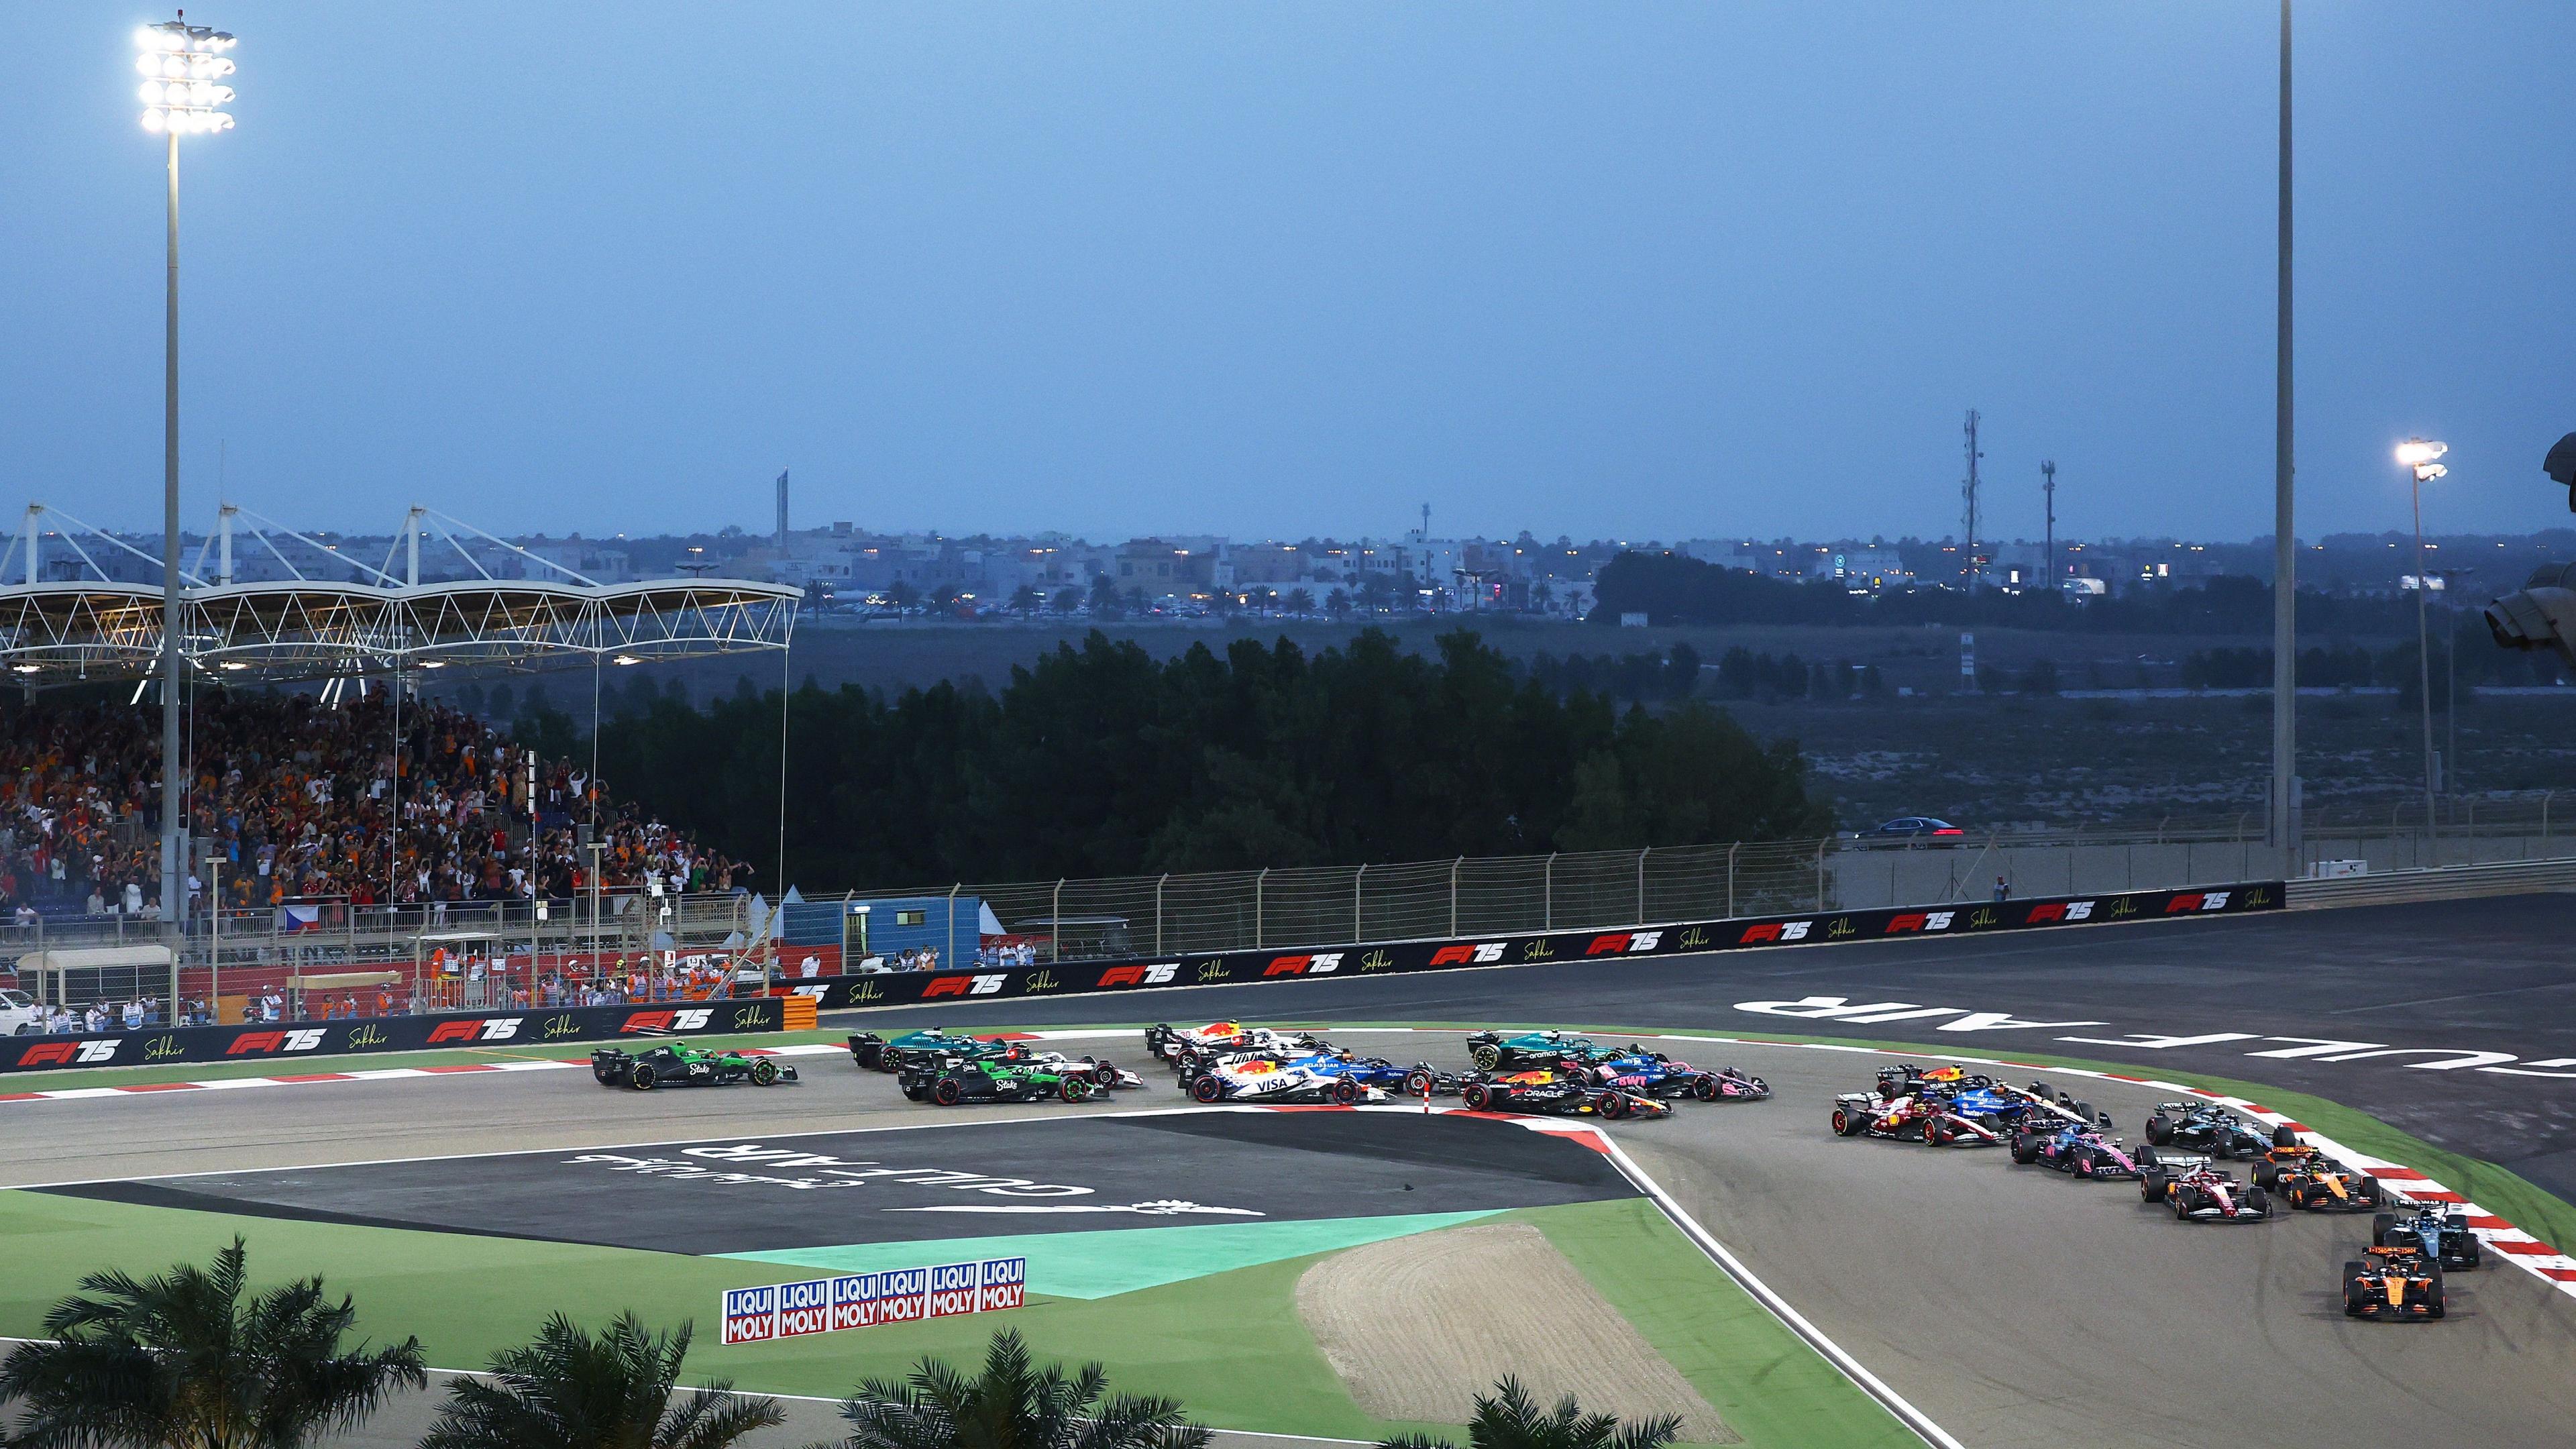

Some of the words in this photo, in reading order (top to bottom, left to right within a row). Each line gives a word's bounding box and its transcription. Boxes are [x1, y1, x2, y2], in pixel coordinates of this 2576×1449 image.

[2026, 904, 2068, 923] F1
[2065, 901, 2096, 920] 75
[2165, 894, 2204, 913] F1
[2202, 892, 2231, 910] 75
[1739, 923, 1784, 943] F1
[1781, 922, 1813, 941] 75
[1828, 918, 1856, 938] Sakhir
[1885, 913, 1927, 933] F1
[1925, 912, 1955, 930] 75
[1586, 934, 1631, 955] F1
[1629, 931, 1664, 951] 75
[1680, 927, 1709, 949] Sakhir
[1362, 949, 1392, 971] Sakhir
[1430, 945, 1476, 965] F1
[1474, 943, 1507, 962] 75
[1525, 939, 1554, 961] Sakhir
[1097, 966, 1146, 986] F1
[1144, 963, 1180, 983] 75
[1199, 959, 1230, 981] Sakhir
[1264, 955, 1312, 975] F1
[1309, 953, 1344, 973] 75
[849, 981, 883, 1004] Sakhir
[922, 976, 973, 997] F1
[970, 974, 1008, 994] 75
[1026, 970, 1059, 993] Sakhir
[619, 1011, 676, 1032] F1
[672, 1009, 714, 1030] 75
[735, 1006, 771, 1028] Sakhir
[1733, 997, 2110, 1031] AIR
[348, 1024, 387, 1049] Sakhir
[427, 1020, 484, 1043] F1
[481, 1018, 524, 1039] 75
[543, 1014, 581, 1038] Sakhir
[18, 1042, 79, 1065] F1
[76, 1040, 121, 1062] 75
[145, 1036, 184, 1061] Sakhir
[226, 1032, 286, 1054] F1
[283, 1028, 327, 1051] 75
[1529, 1050, 1557, 1059] aramco
[690, 1063, 710, 1075] Stake
[963, 1064, 977, 1072] Stake
[996, 1079, 1018, 1091] Stake
[1257, 1079, 1287, 1091] VISA
[1619, 1076, 1647, 1086] BWT
[681, 1145, 880, 1167] AIR
[818, 1169, 1095, 1196] GULF
[881, 1271, 924, 1295] LIQUI
[934, 1266, 975, 1290] LIQUI
[984, 1260, 1024, 1284] LIQUI
[782, 1283, 824, 1309] LIQUI
[835, 1277, 876, 1302] LIQUI
[983, 1285, 1024, 1309] MOLY
[730, 1289, 772, 1316] LIQUI
[881, 1296, 924, 1321] MOLY
[932, 1290, 974, 1315] MOLY
[782, 1308, 826, 1334] MOLY
[835, 1301, 877, 1328] MOLY
[729, 1315, 773, 1341] MOLY
